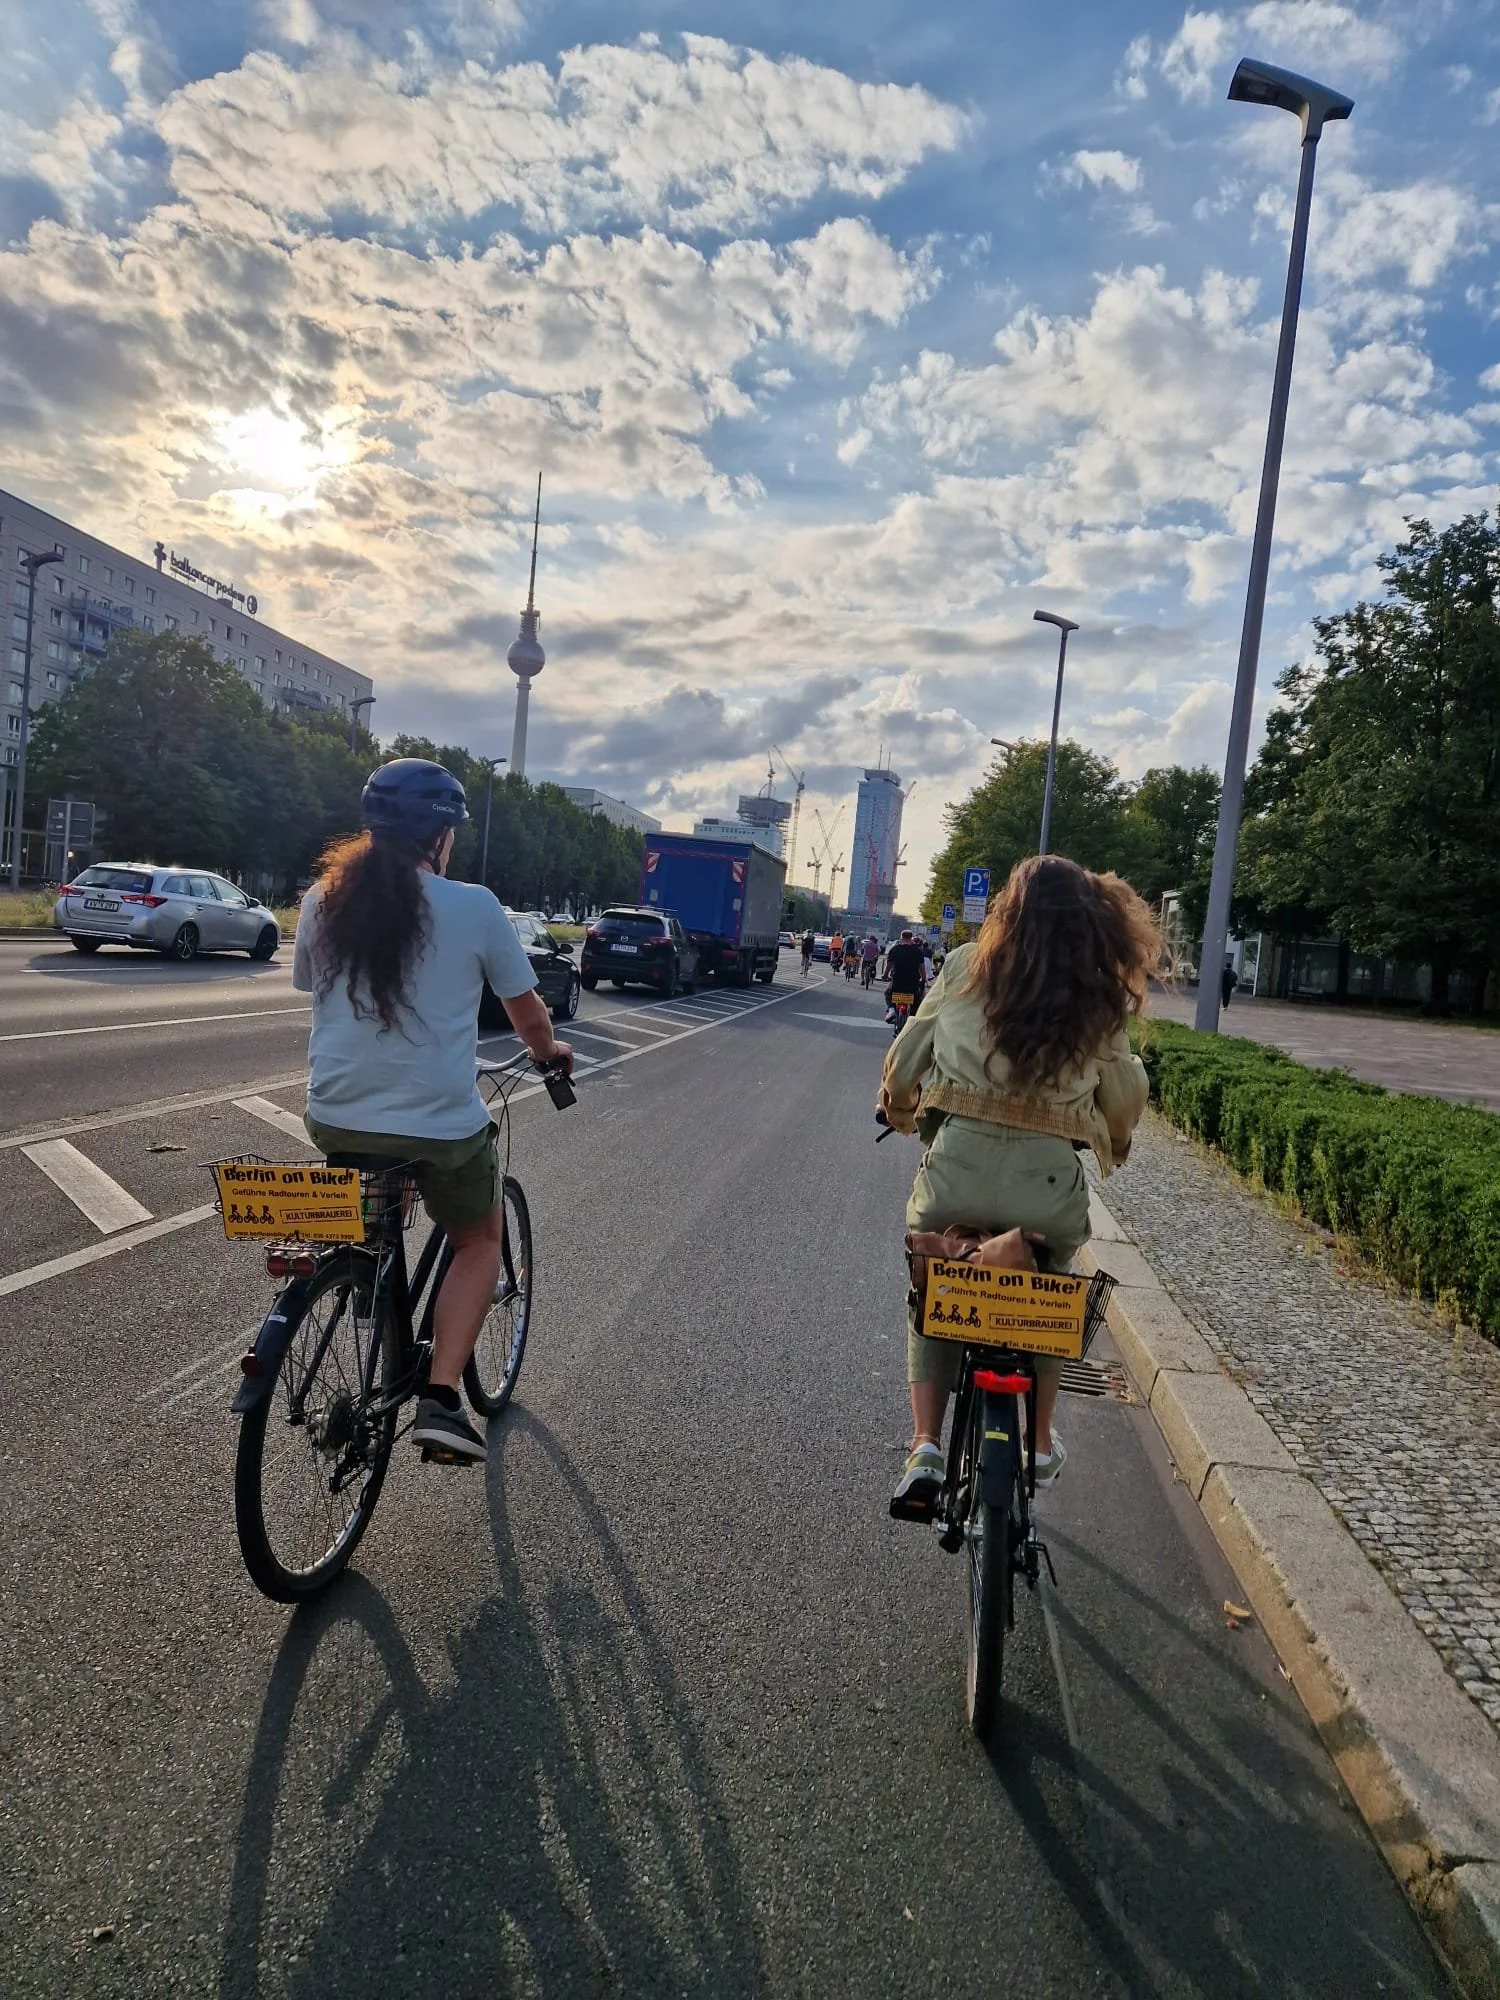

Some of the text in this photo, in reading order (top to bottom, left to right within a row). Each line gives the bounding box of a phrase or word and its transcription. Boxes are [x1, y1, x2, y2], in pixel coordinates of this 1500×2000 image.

[968, 872, 982, 892] P
[224, 1168, 354, 1186] Berlin on Bike!
[232, 1188, 267, 1197] Geführte
[268, 1189, 310, 1198] Radtouren
[320, 1191, 348, 1199] Verleih
[285, 1211, 352, 1221] KULTURBRAUEREI
[933, 1262, 1082, 1295] Berlin on Bike!
[938, 1285, 1071, 1310] führte Radtouren & Verleih
[995, 1317, 1073, 1330] KULTURBRAUEREI
